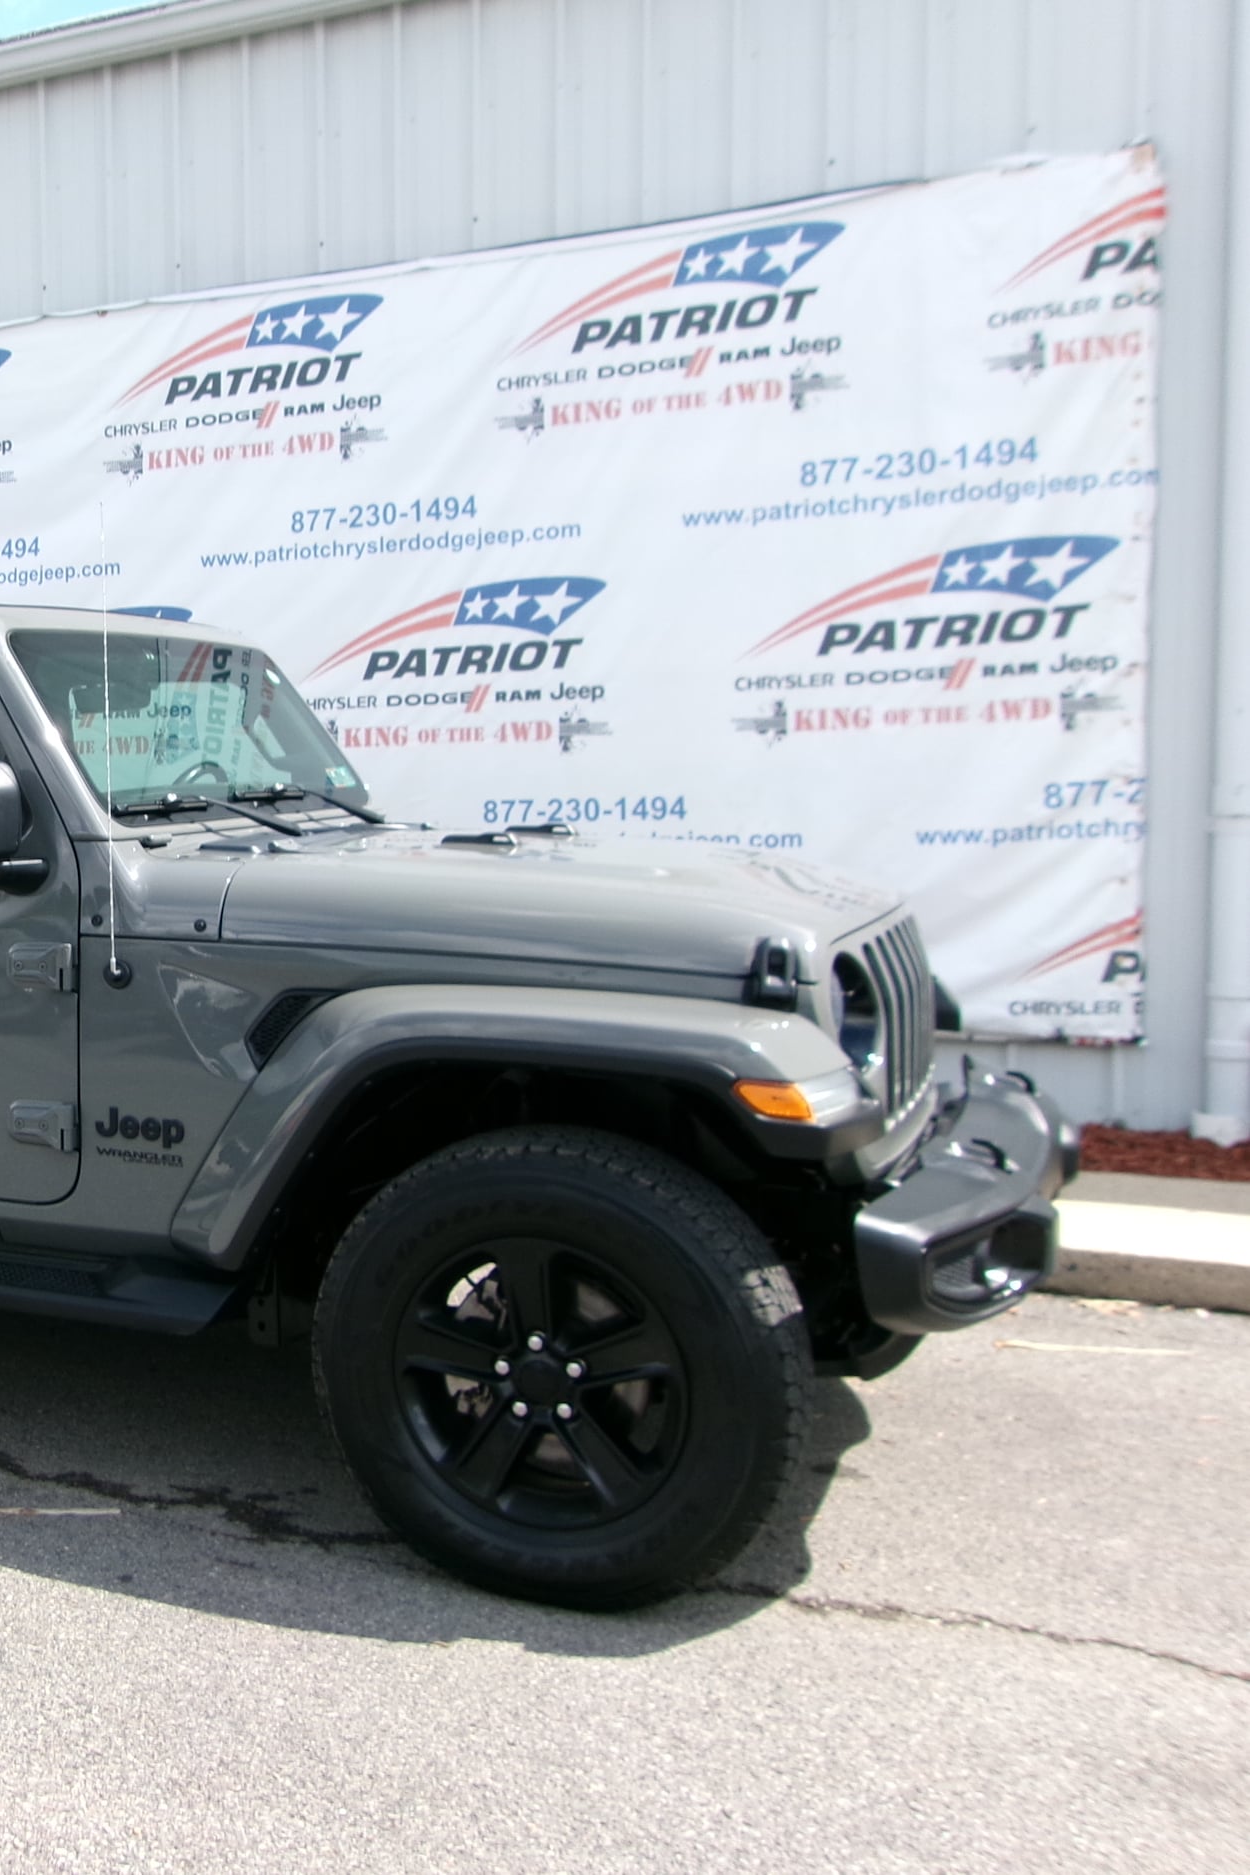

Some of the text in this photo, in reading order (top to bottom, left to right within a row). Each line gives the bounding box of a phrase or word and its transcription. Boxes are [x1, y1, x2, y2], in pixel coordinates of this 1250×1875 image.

[572, 287, 819, 354] PATRIOT
[987, 298, 1101, 328] CHRYSLER
[497, 336, 842, 392] CHRYSLER DODGE RAM Jeep
[1054, 330, 1141, 365] KING
[165, 352, 362, 406] PATRIOT
[104, 394, 382, 438] CHRYSLER DODGE RAM Jeep
[551, 379, 783, 427] KING OF THE 4WD
[148, 432, 335, 471] KING OF THE 4WD
[801, 436, 1038, 487] 877-230-1494
[291, 495, 477, 533] 877-230-1494
[200, 523, 581, 568] www.patriotchryslerdodgejeep.com
[816, 602, 1092, 657] PATRIOT
[363, 638, 584, 681] PATRIOT
[734, 652, 1119, 692] CHRYSLER DODGE RAM Jeep
[306, 682, 605, 711] HRYSLER DODGE RAM Jeep
[794, 697, 1053, 732] KING OF THE 4WD
[344, 720, 554, 749] KING OF THE 4WD
[483, 795, 688, 823] 877-230-1494
[1009, 1000, 1121, 1016] CHRYSLER
[95, 1106, 185, 1149] Jeep
[96, 1145, 183, 1163] WRANGLER
